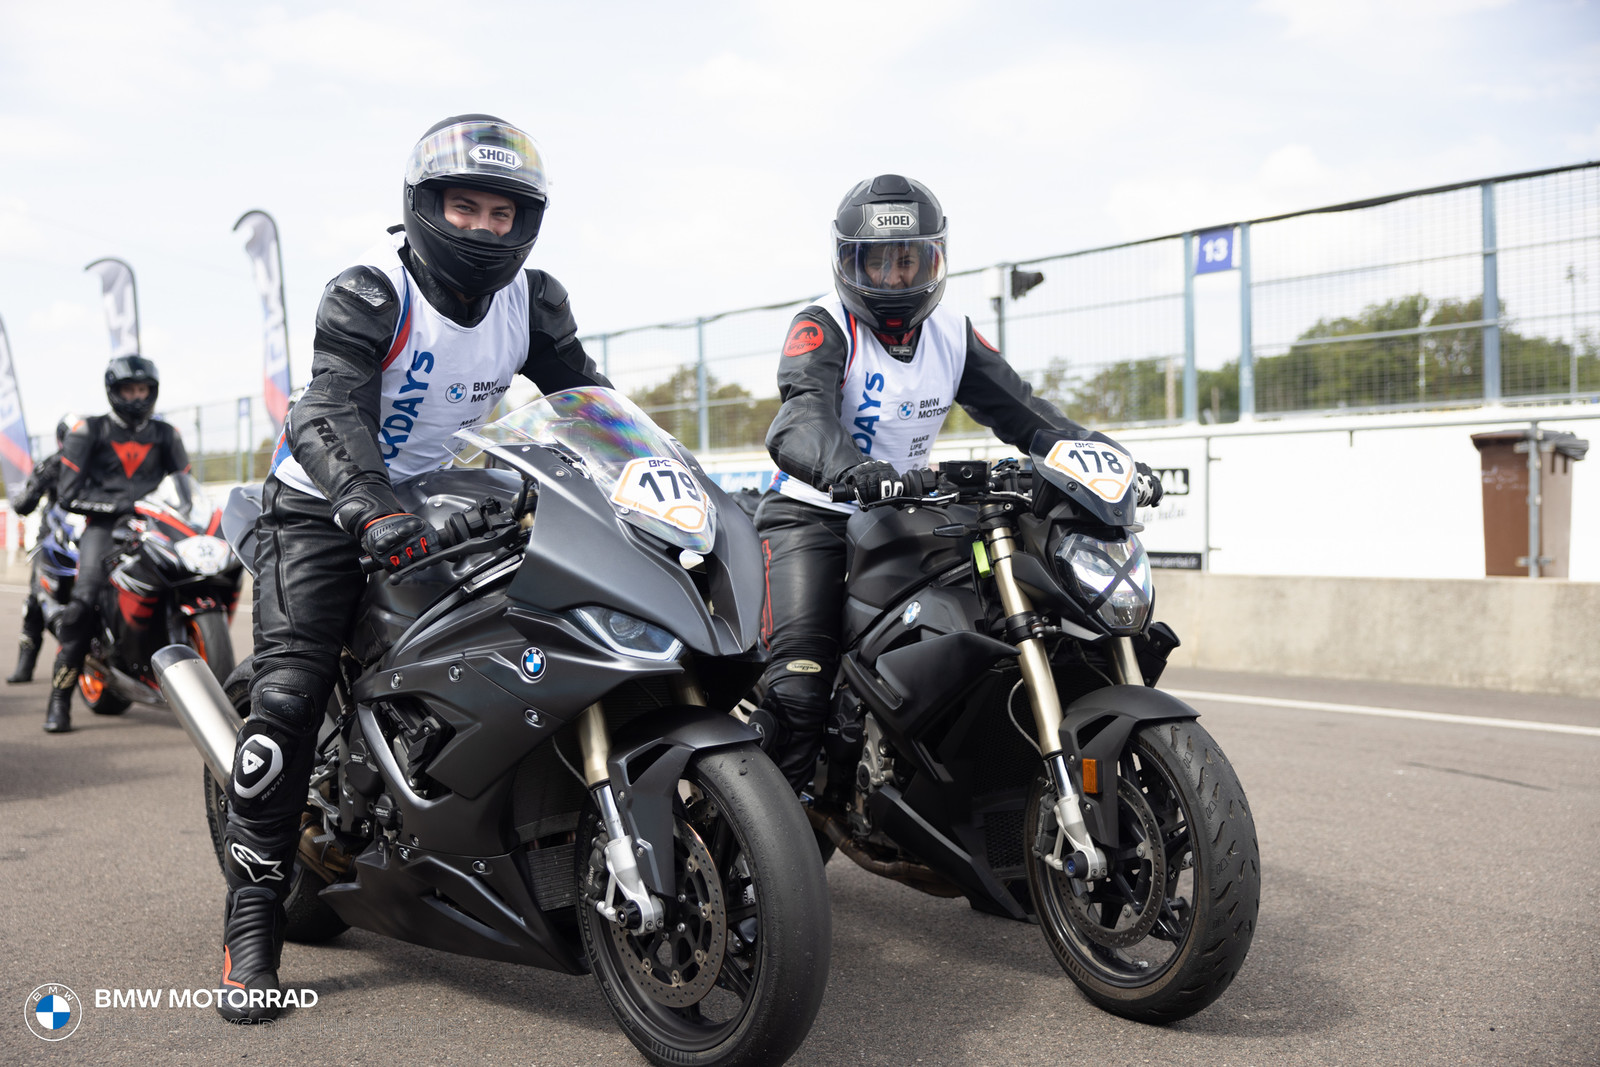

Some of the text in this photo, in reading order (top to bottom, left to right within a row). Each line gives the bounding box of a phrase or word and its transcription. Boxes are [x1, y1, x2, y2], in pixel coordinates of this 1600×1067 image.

[478, 148, 516, 166] SHOEI
[876, 215, 910, 227] SHOEI
[1203, 238, 1228, 263] 13
[473, 378, 499, 392] BMW
[379, 350, 435, 468] CKDAYS
[920, 397, 940, 409] BMW
[912, 435, 930, 444] MAKE
[910, 443, 923, 451] LIFE
[913, 448, 927, 458] RIDE
[649, 459, 672, 468] BMC
[1068, 450, 1124, 475] 178
[639, 470, 701, 502] 179
[1151, 470, 1188, 494] AL
